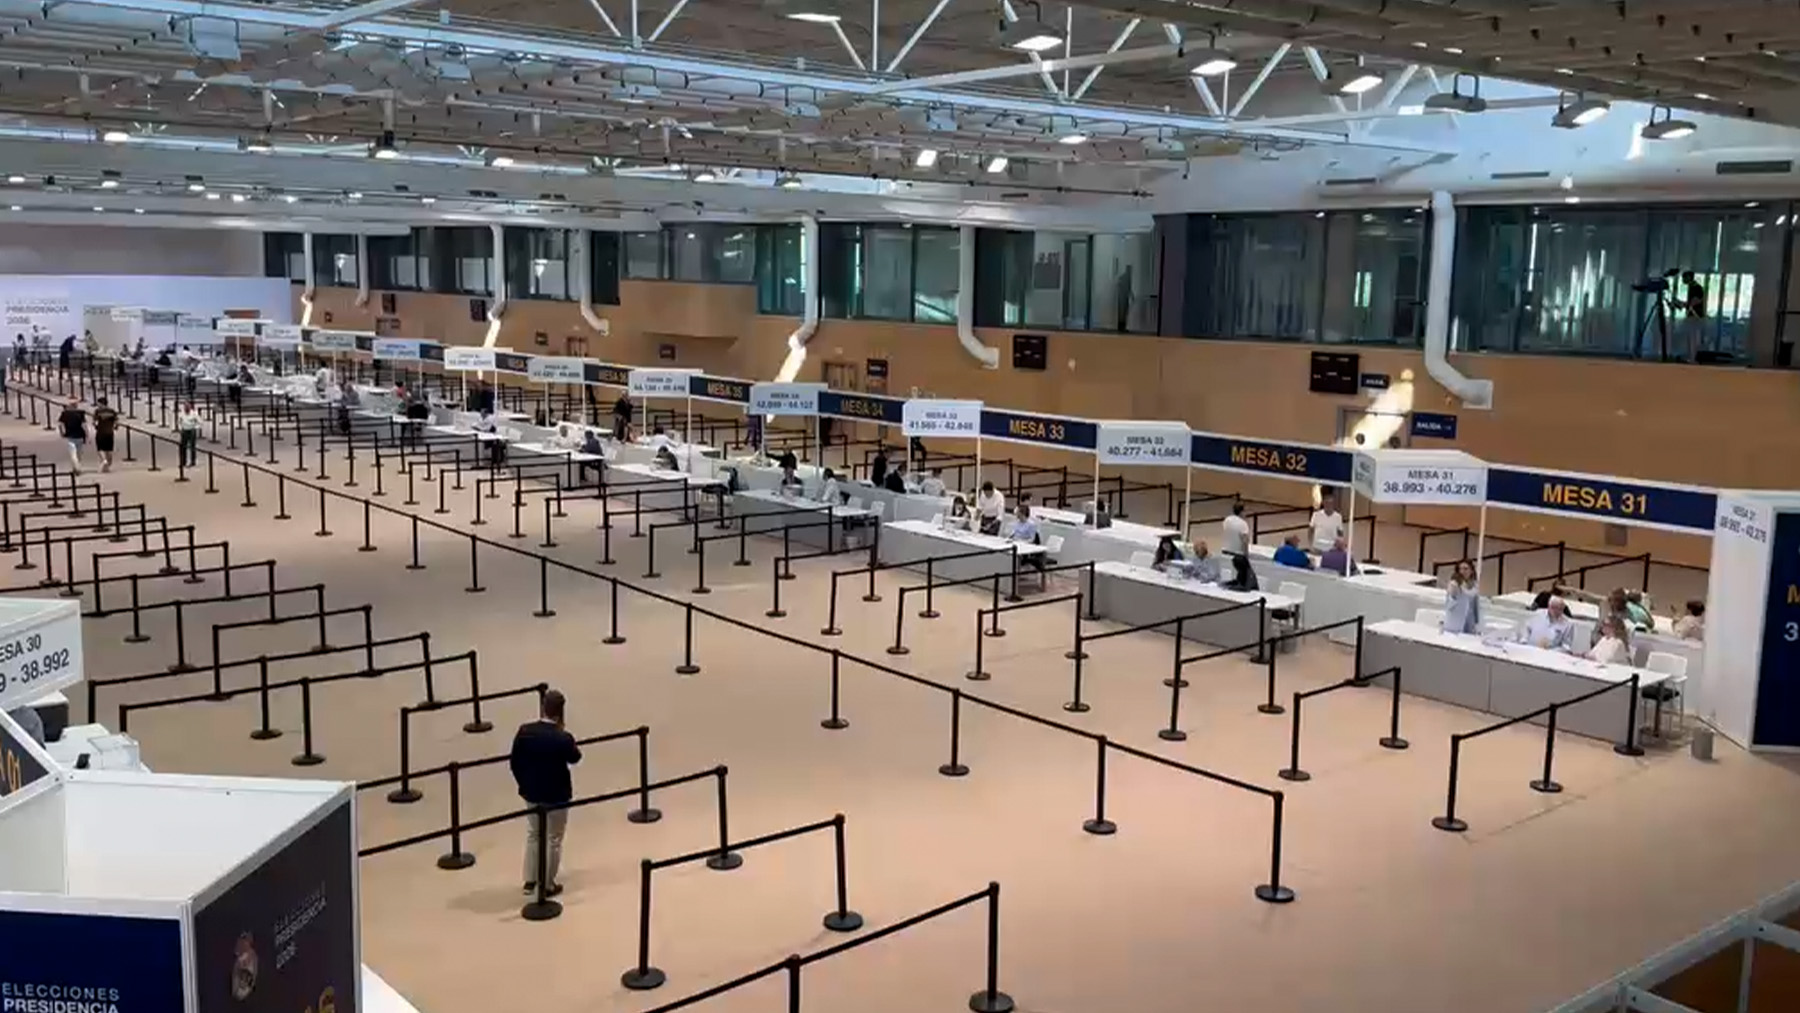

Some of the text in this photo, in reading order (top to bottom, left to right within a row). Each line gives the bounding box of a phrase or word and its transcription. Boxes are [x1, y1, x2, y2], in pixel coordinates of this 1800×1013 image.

[707, 381, 730, 397] MESA
[841, 399, 884, 417] MESA 34
[1009, 419, 1065, 440] MESA 33
[1127, 436, 1152, 445] MESA
[1107, 446, 1142, 456] 40.277
[1231, 446, 1307, 472] MESA 32
[1408, 470, 1454, 480] MESA 31
[1383, 481, 1425, 493] 38.993
[1436, 483, 1477, 495] 40.276
[1543, 483, 1647, 515] MESA 31
[26, 634, 42, 651] 30
[20, 648, 69, 685] 38.992
[2, 982, 120, 1001] ELECCIONES
[4, 998, 120, 1013] PRESIDENCIA
